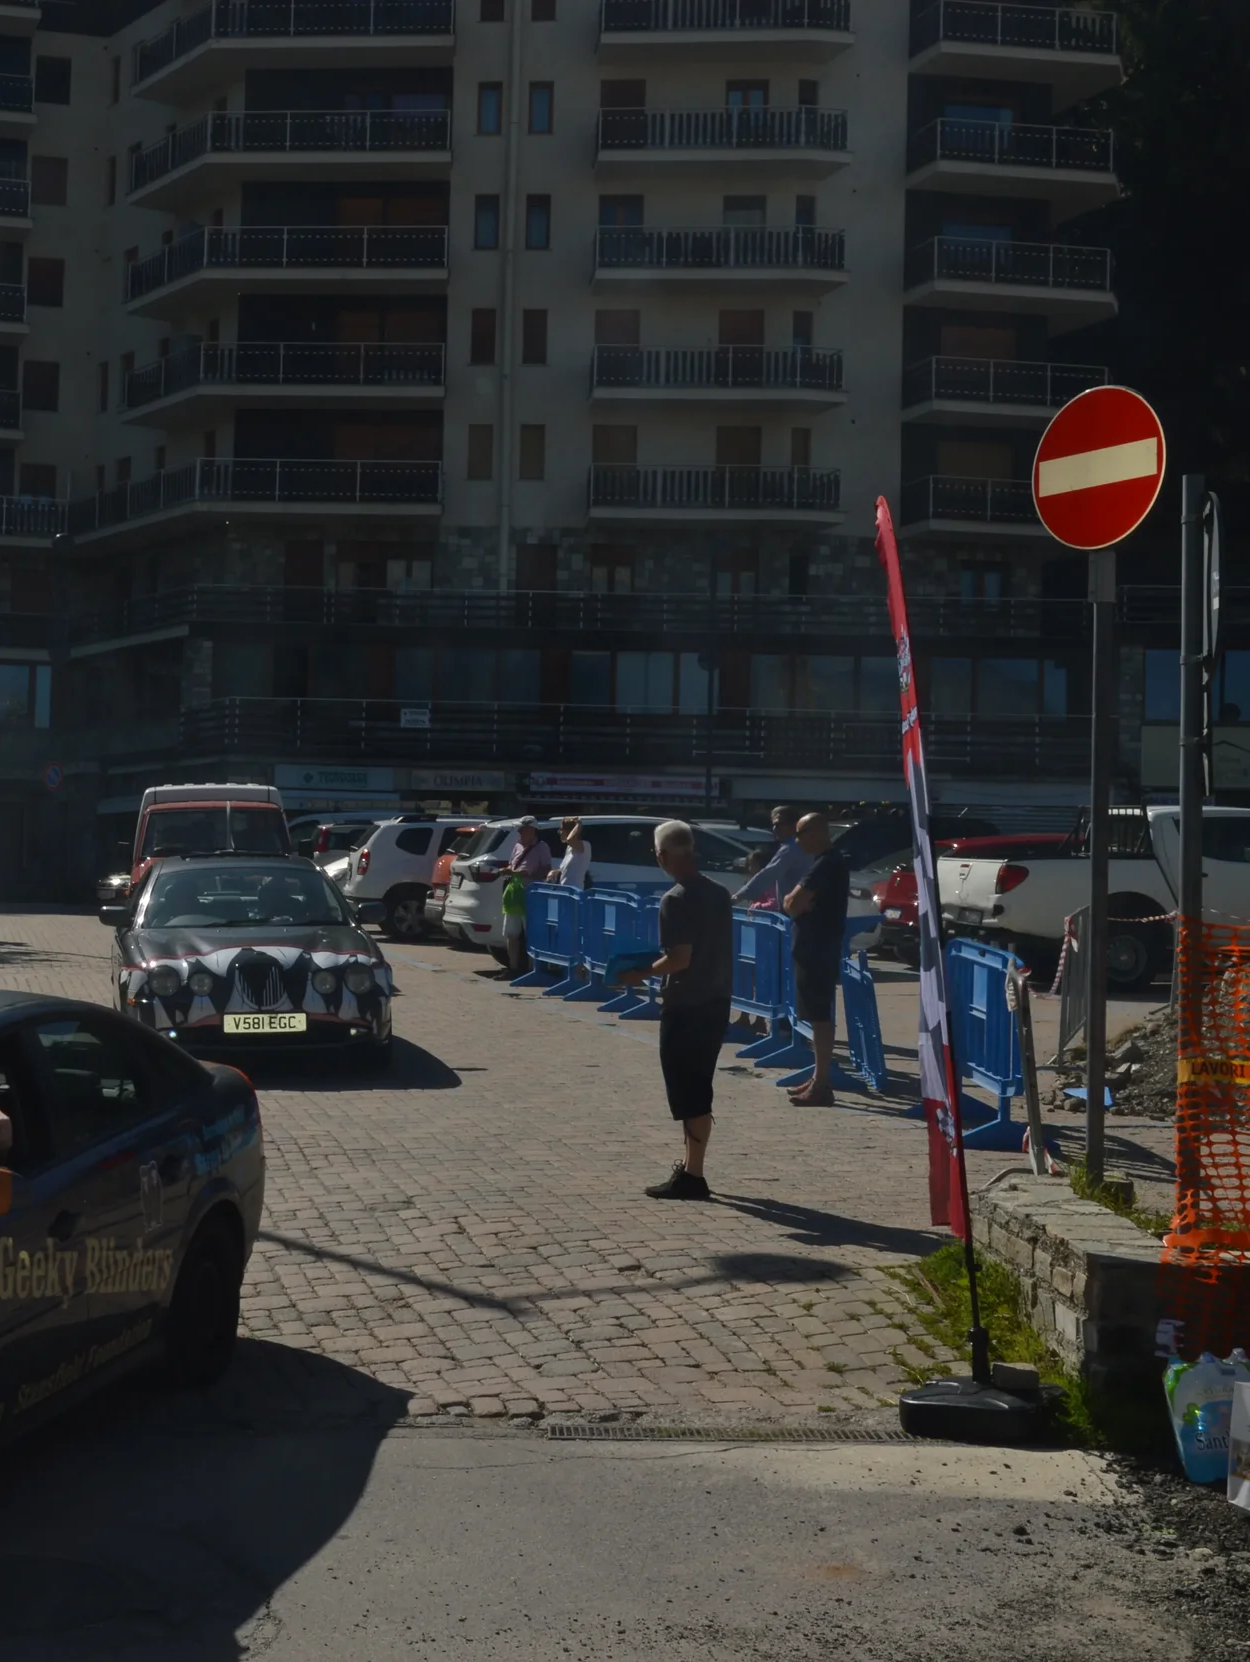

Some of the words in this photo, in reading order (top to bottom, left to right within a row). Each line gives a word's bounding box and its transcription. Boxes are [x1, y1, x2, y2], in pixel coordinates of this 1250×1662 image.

[433, 774, 483, 787] OLIMPIA
[233, 1015, 265, 1030] V581
[269, 1014, 297, 1029] EGC
[1191, 1061, 1246, 1078] LAVORI
[84, 1236, 175, 1296] Blinders
